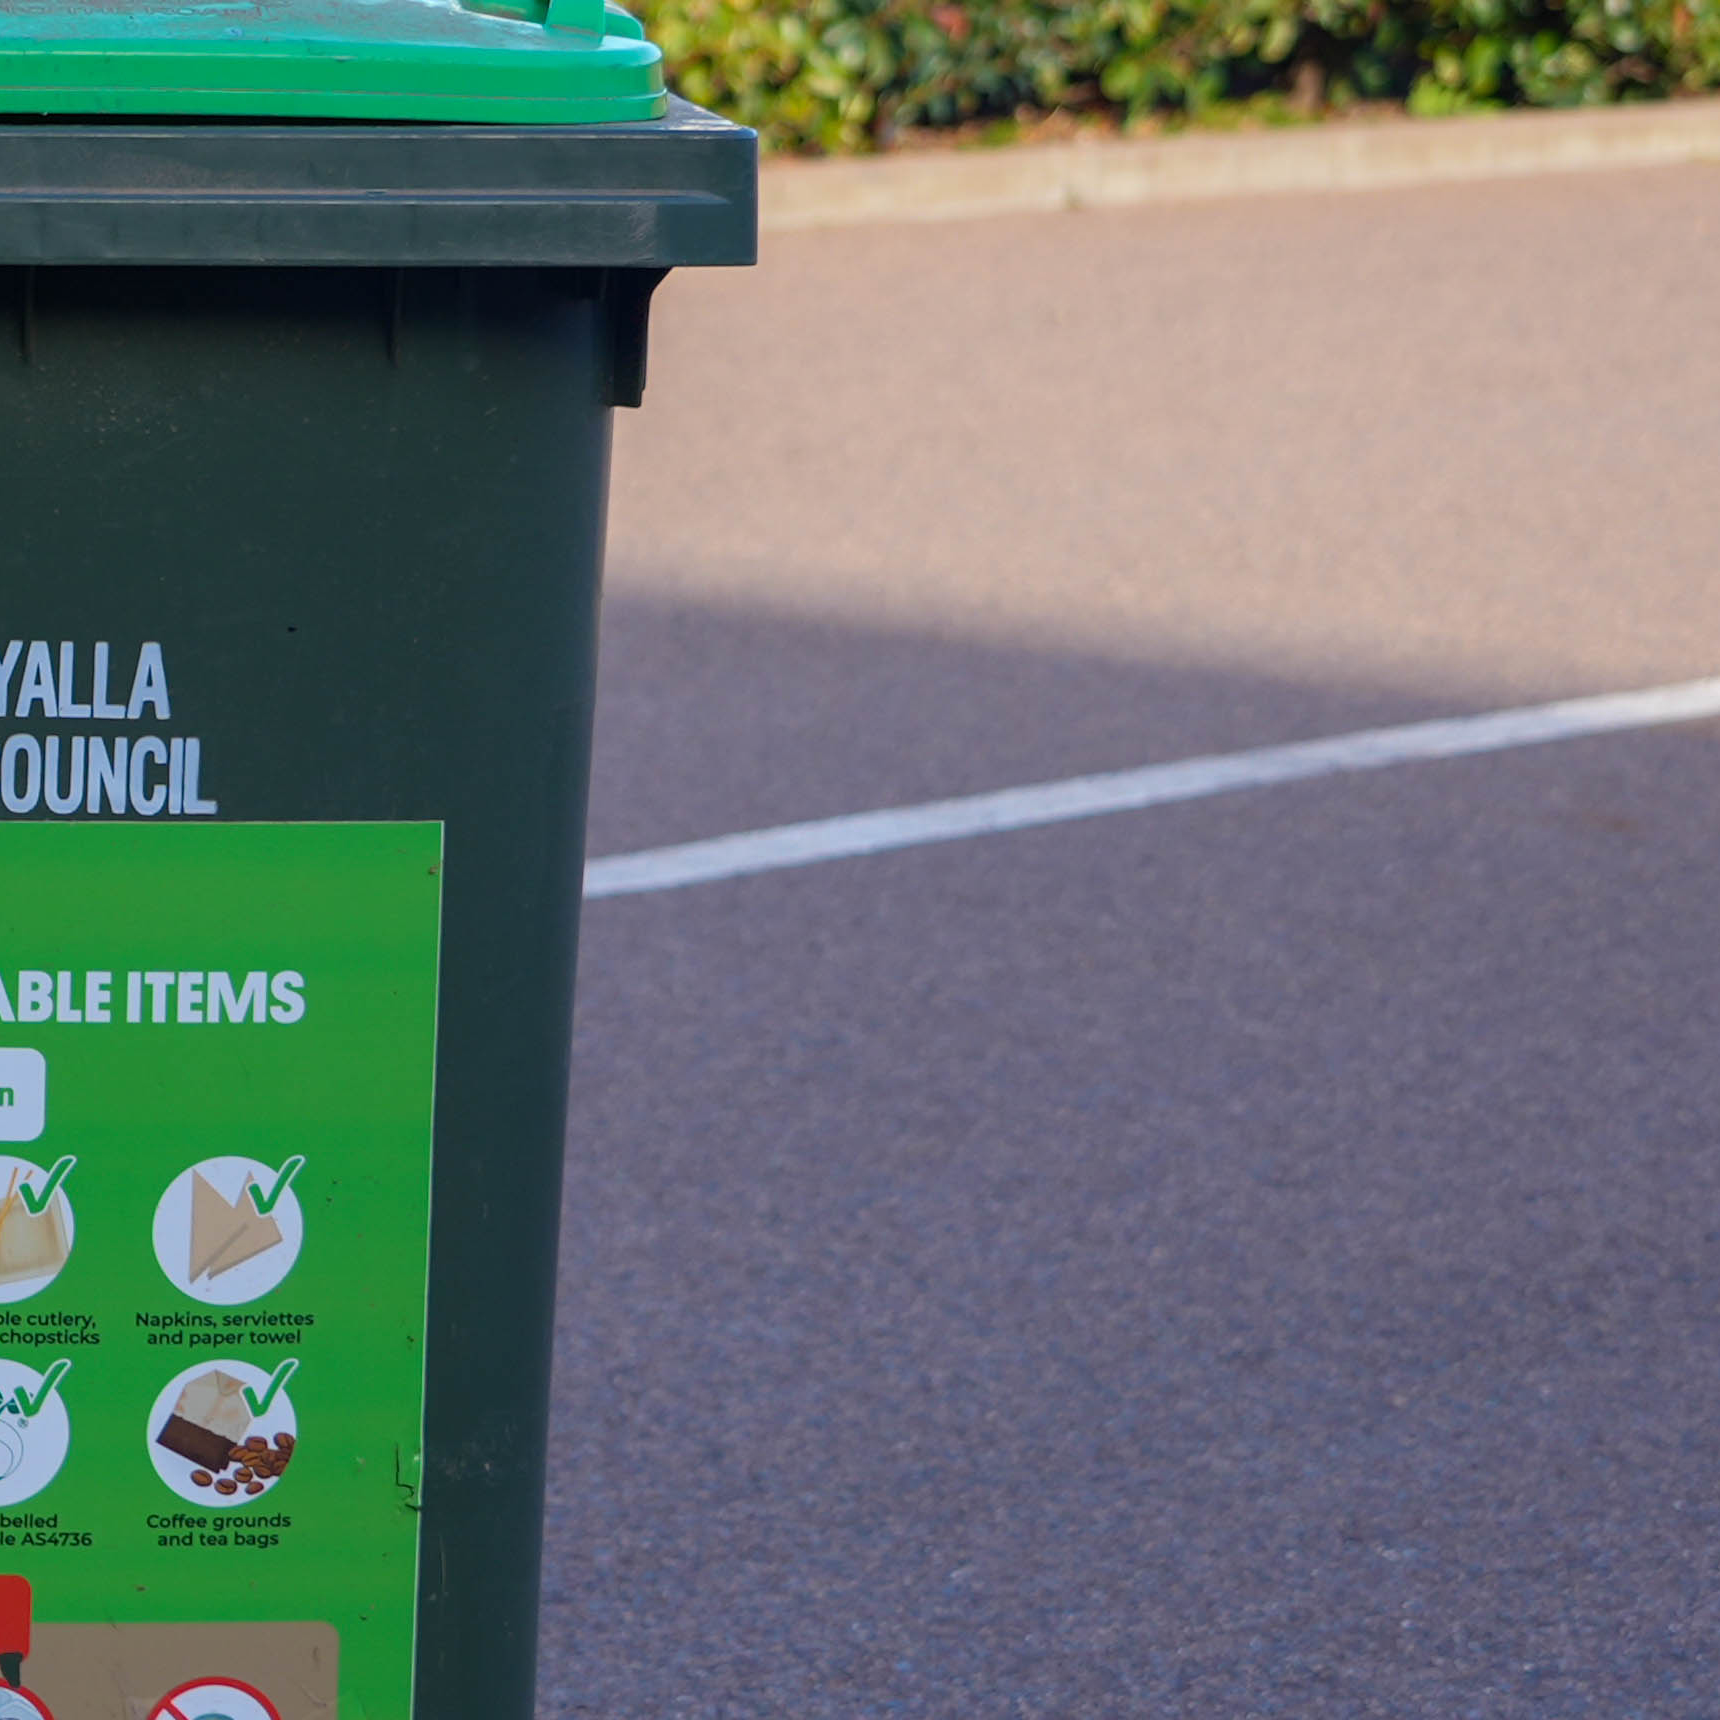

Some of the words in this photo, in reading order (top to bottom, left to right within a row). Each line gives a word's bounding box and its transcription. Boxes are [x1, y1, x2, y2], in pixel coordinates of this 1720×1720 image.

[126, 970, 305, 1025] ITEMS
[27, 1312, 97, 1330] cutlery,
[135, 1311, 217, 1329] Napkins,
[221, 1312, 314, 1327] serviettes
[0, 1329, 100, 1346] chopsticks
[147, 1330, 183, 1345] and
[189, 1332, 245, 1348] paper
[249, 1330, 301, 1345] towel
[146, 1514, 207, 1529] Coffee
[212, 1513, 291, 1531] grounds
[20, 1532, 93, 1547] AS4736
[157, 1532, 194, 1546] and
[200, 1533, 229, 1546] tea
[234, 1531, 279, 1549] bags
